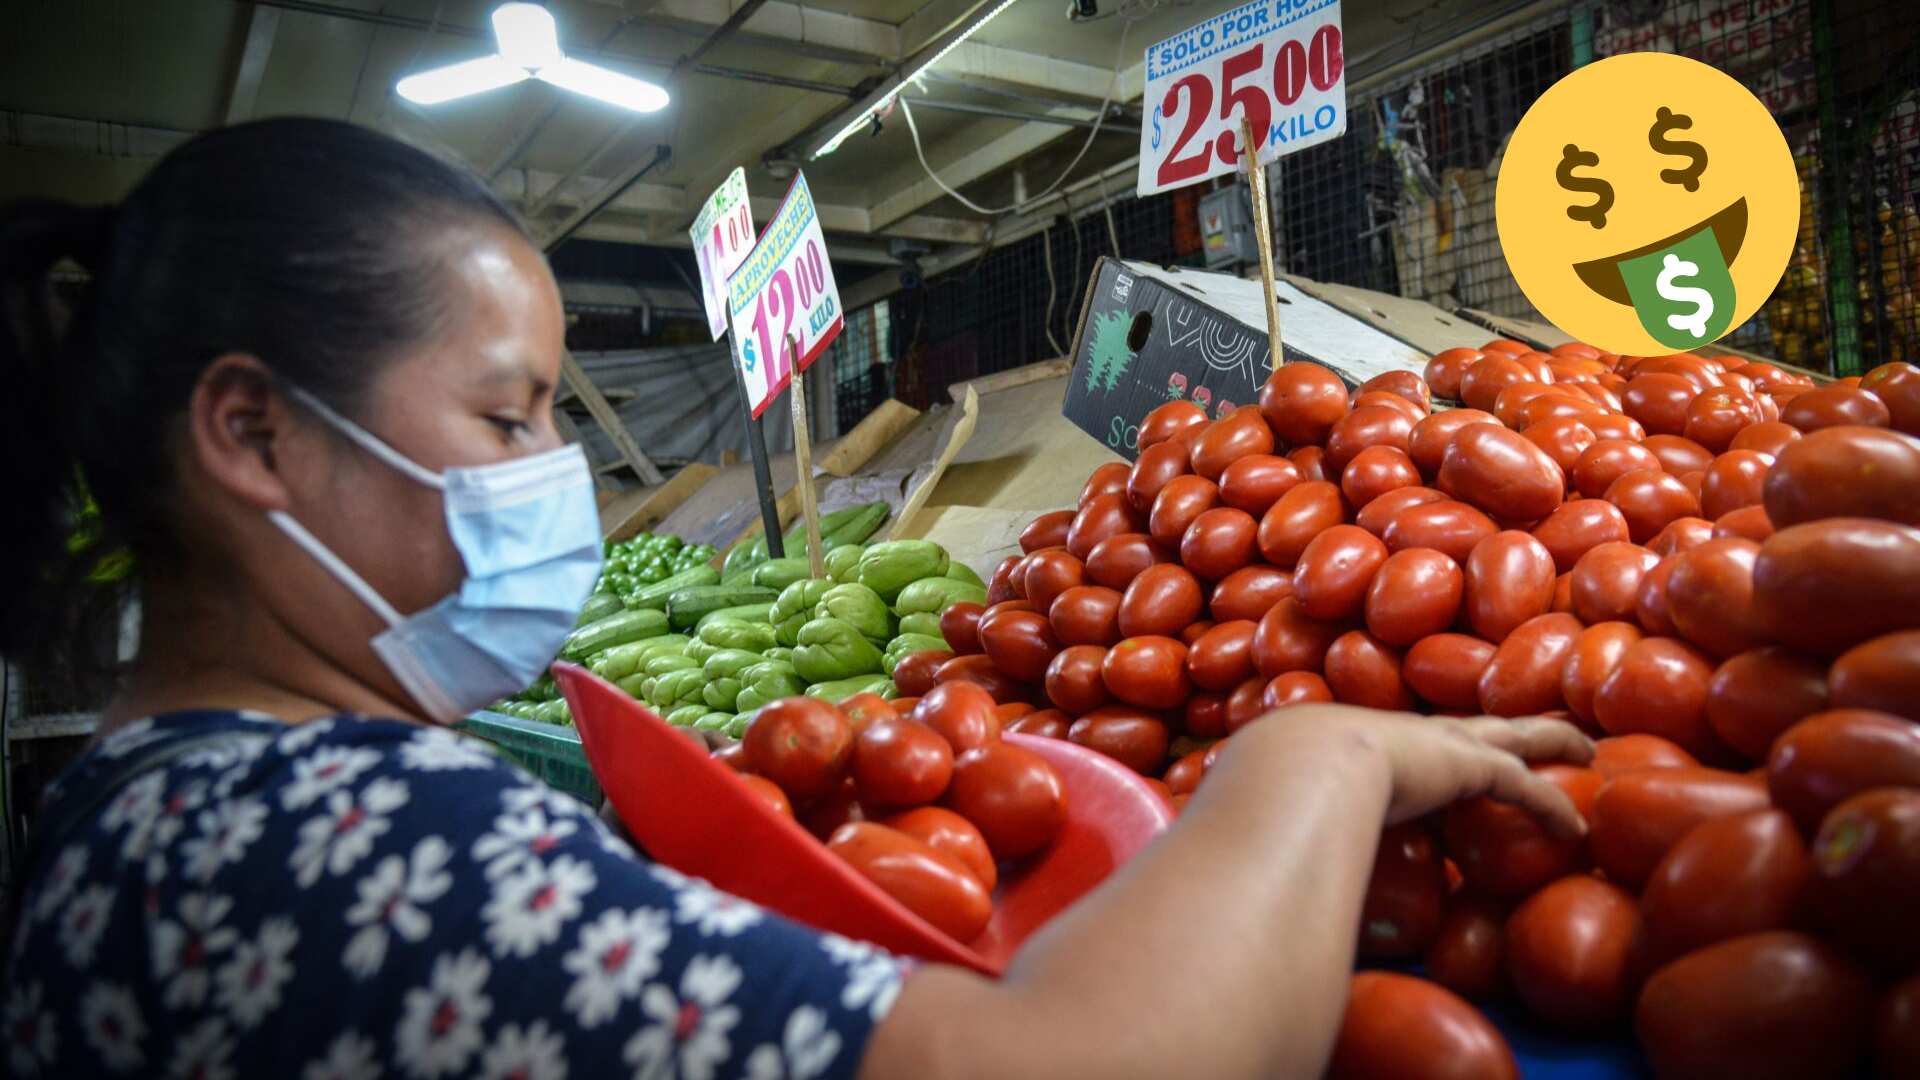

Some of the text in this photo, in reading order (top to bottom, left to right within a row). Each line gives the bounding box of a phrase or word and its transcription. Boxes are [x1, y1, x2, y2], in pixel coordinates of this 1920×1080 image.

[1160, 31, 1215, 66] SOLO
[1222, 8, 1269, 39] POR
[1269, 104, 1336, 146] KILO
[809, 295, 834, 337] KILO
